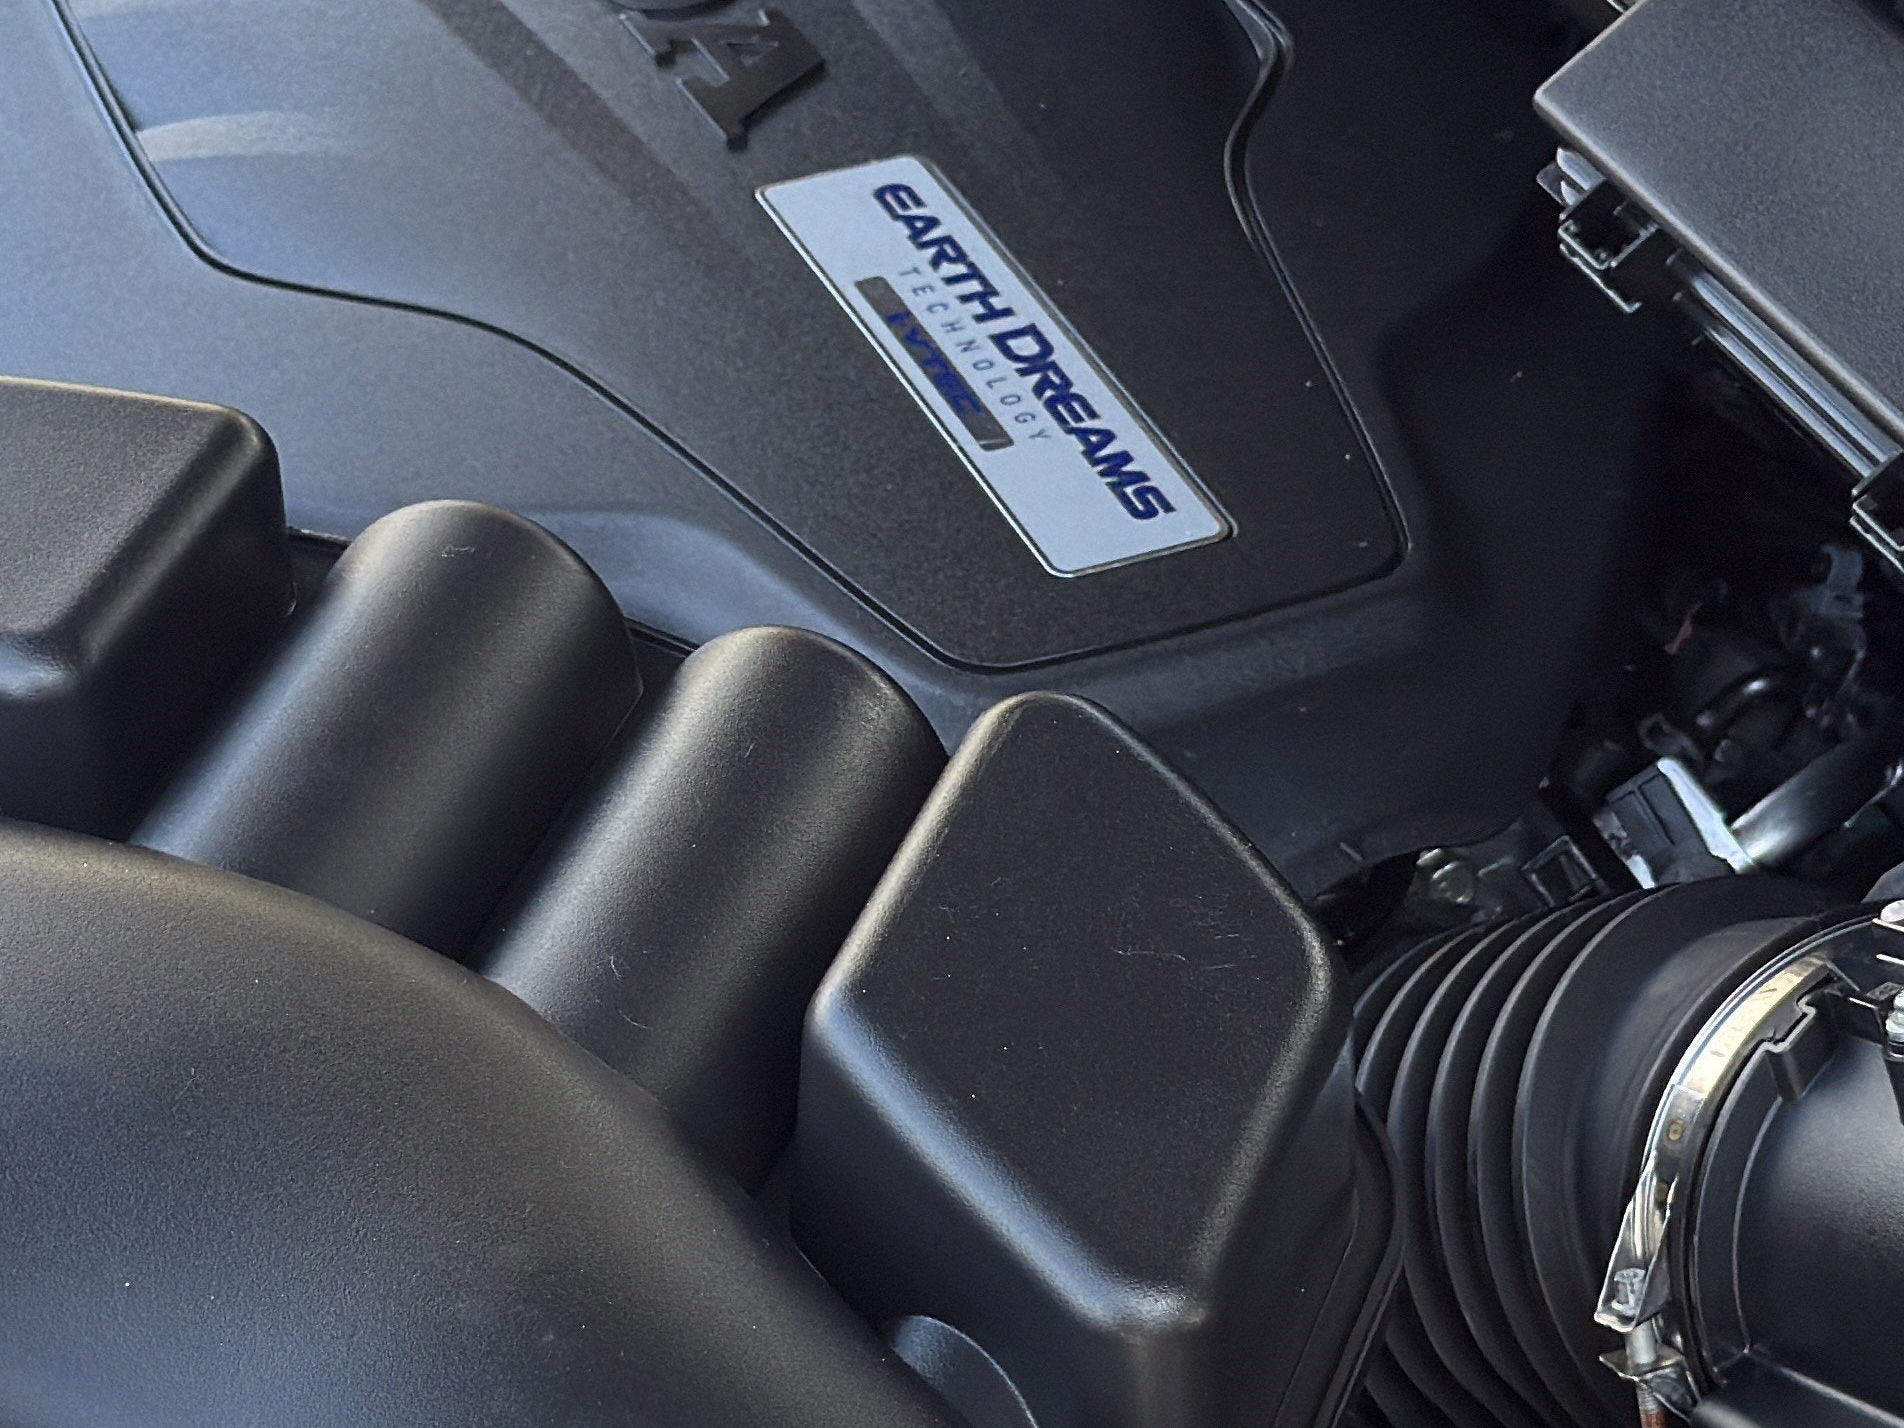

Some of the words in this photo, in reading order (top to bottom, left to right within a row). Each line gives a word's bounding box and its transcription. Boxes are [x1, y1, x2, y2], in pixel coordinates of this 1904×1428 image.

[872, 182, 1016, 324] EARTH
[988, 322, 1178, 521] DREAMS
[899, 265, 1051, 442] TECHNOLOGY
